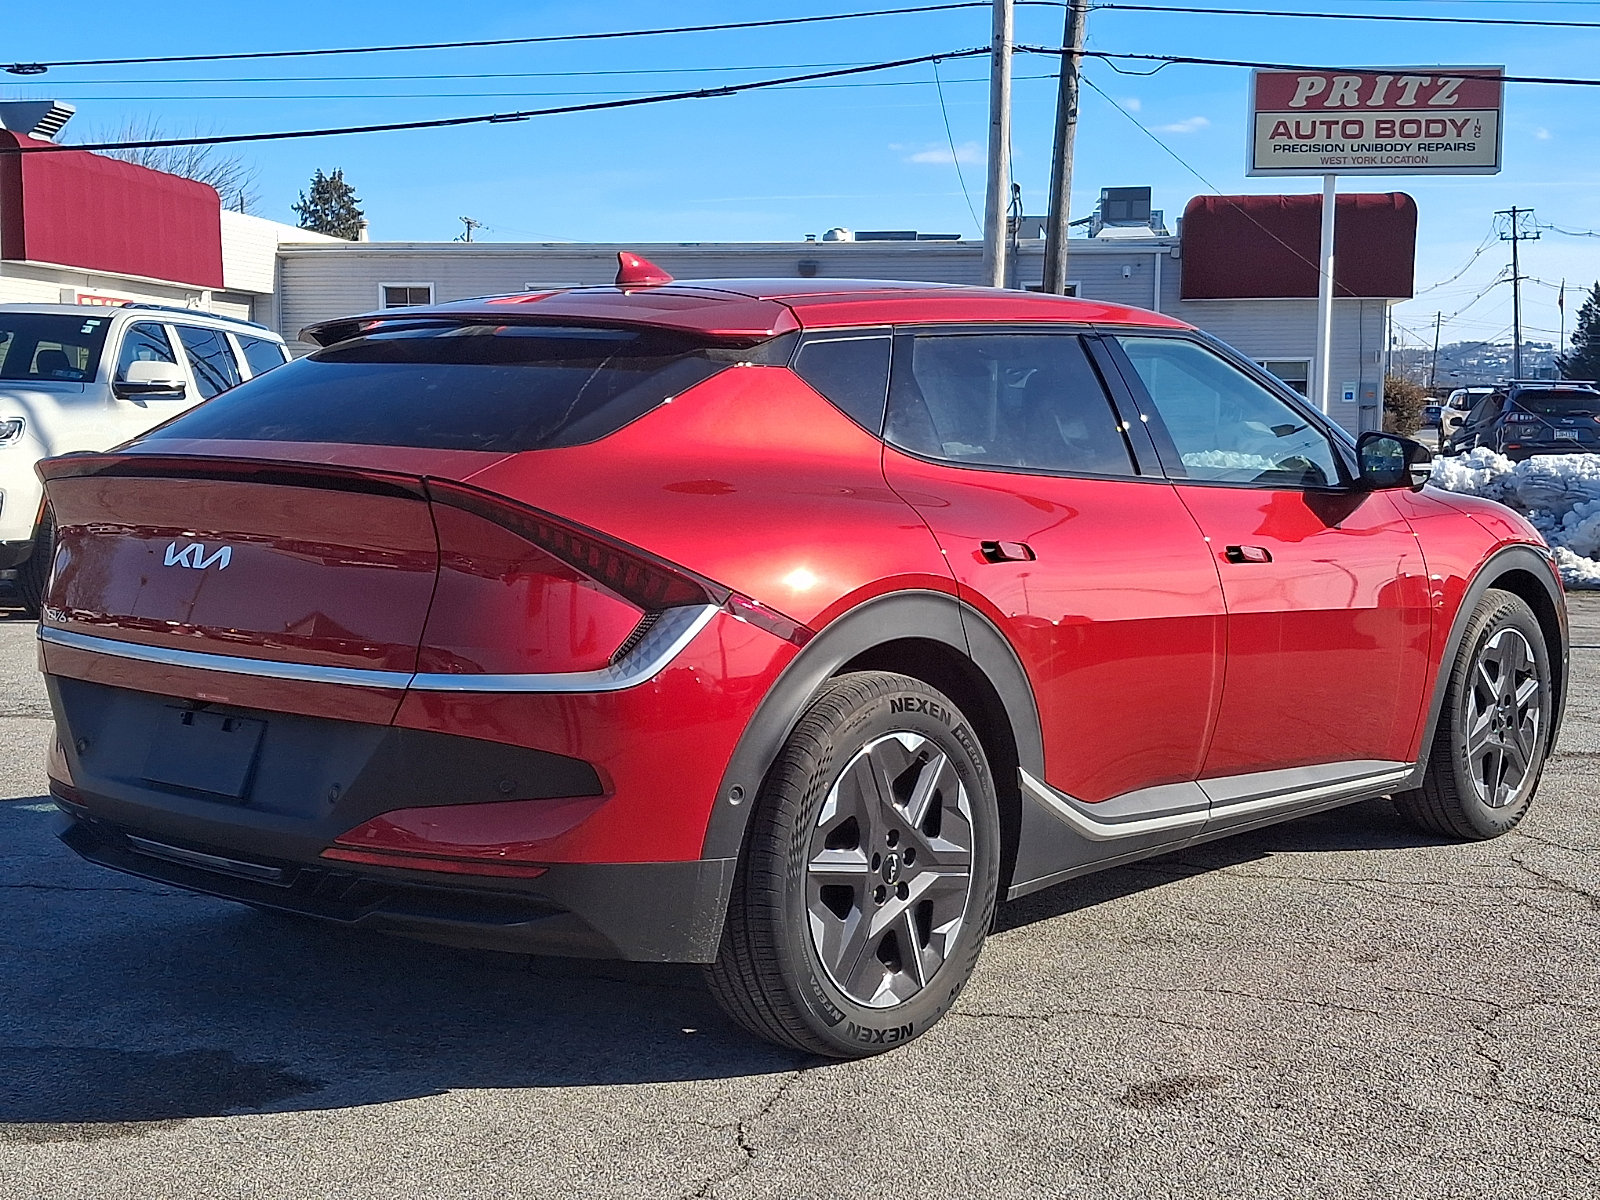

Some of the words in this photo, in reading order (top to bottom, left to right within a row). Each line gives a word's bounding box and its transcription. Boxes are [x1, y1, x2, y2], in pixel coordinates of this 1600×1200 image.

[1288, 75, 1465, 107] PRITZ
[1269, 119, 1364, 140] AUTO
[1375, 118, 1471, 139] BODY
[1473, 118, 1482, 139] INC
[1273, 143, 1345, 153] PRECISION
[1350, 142, 1413, 153] UNIBODY
[1417, 142, 1476, 152] REPAIRS
[1320, 156, 1348, 165] WEST
[1350, 156, 1377, 165] YORK
[1380, 155, 1429, 165] LOCATION
[163, 541, 233, 571] KIA
[890, 697, 952, 727] NEXEN
[846, 1021, 914, 1045] NEXEN
